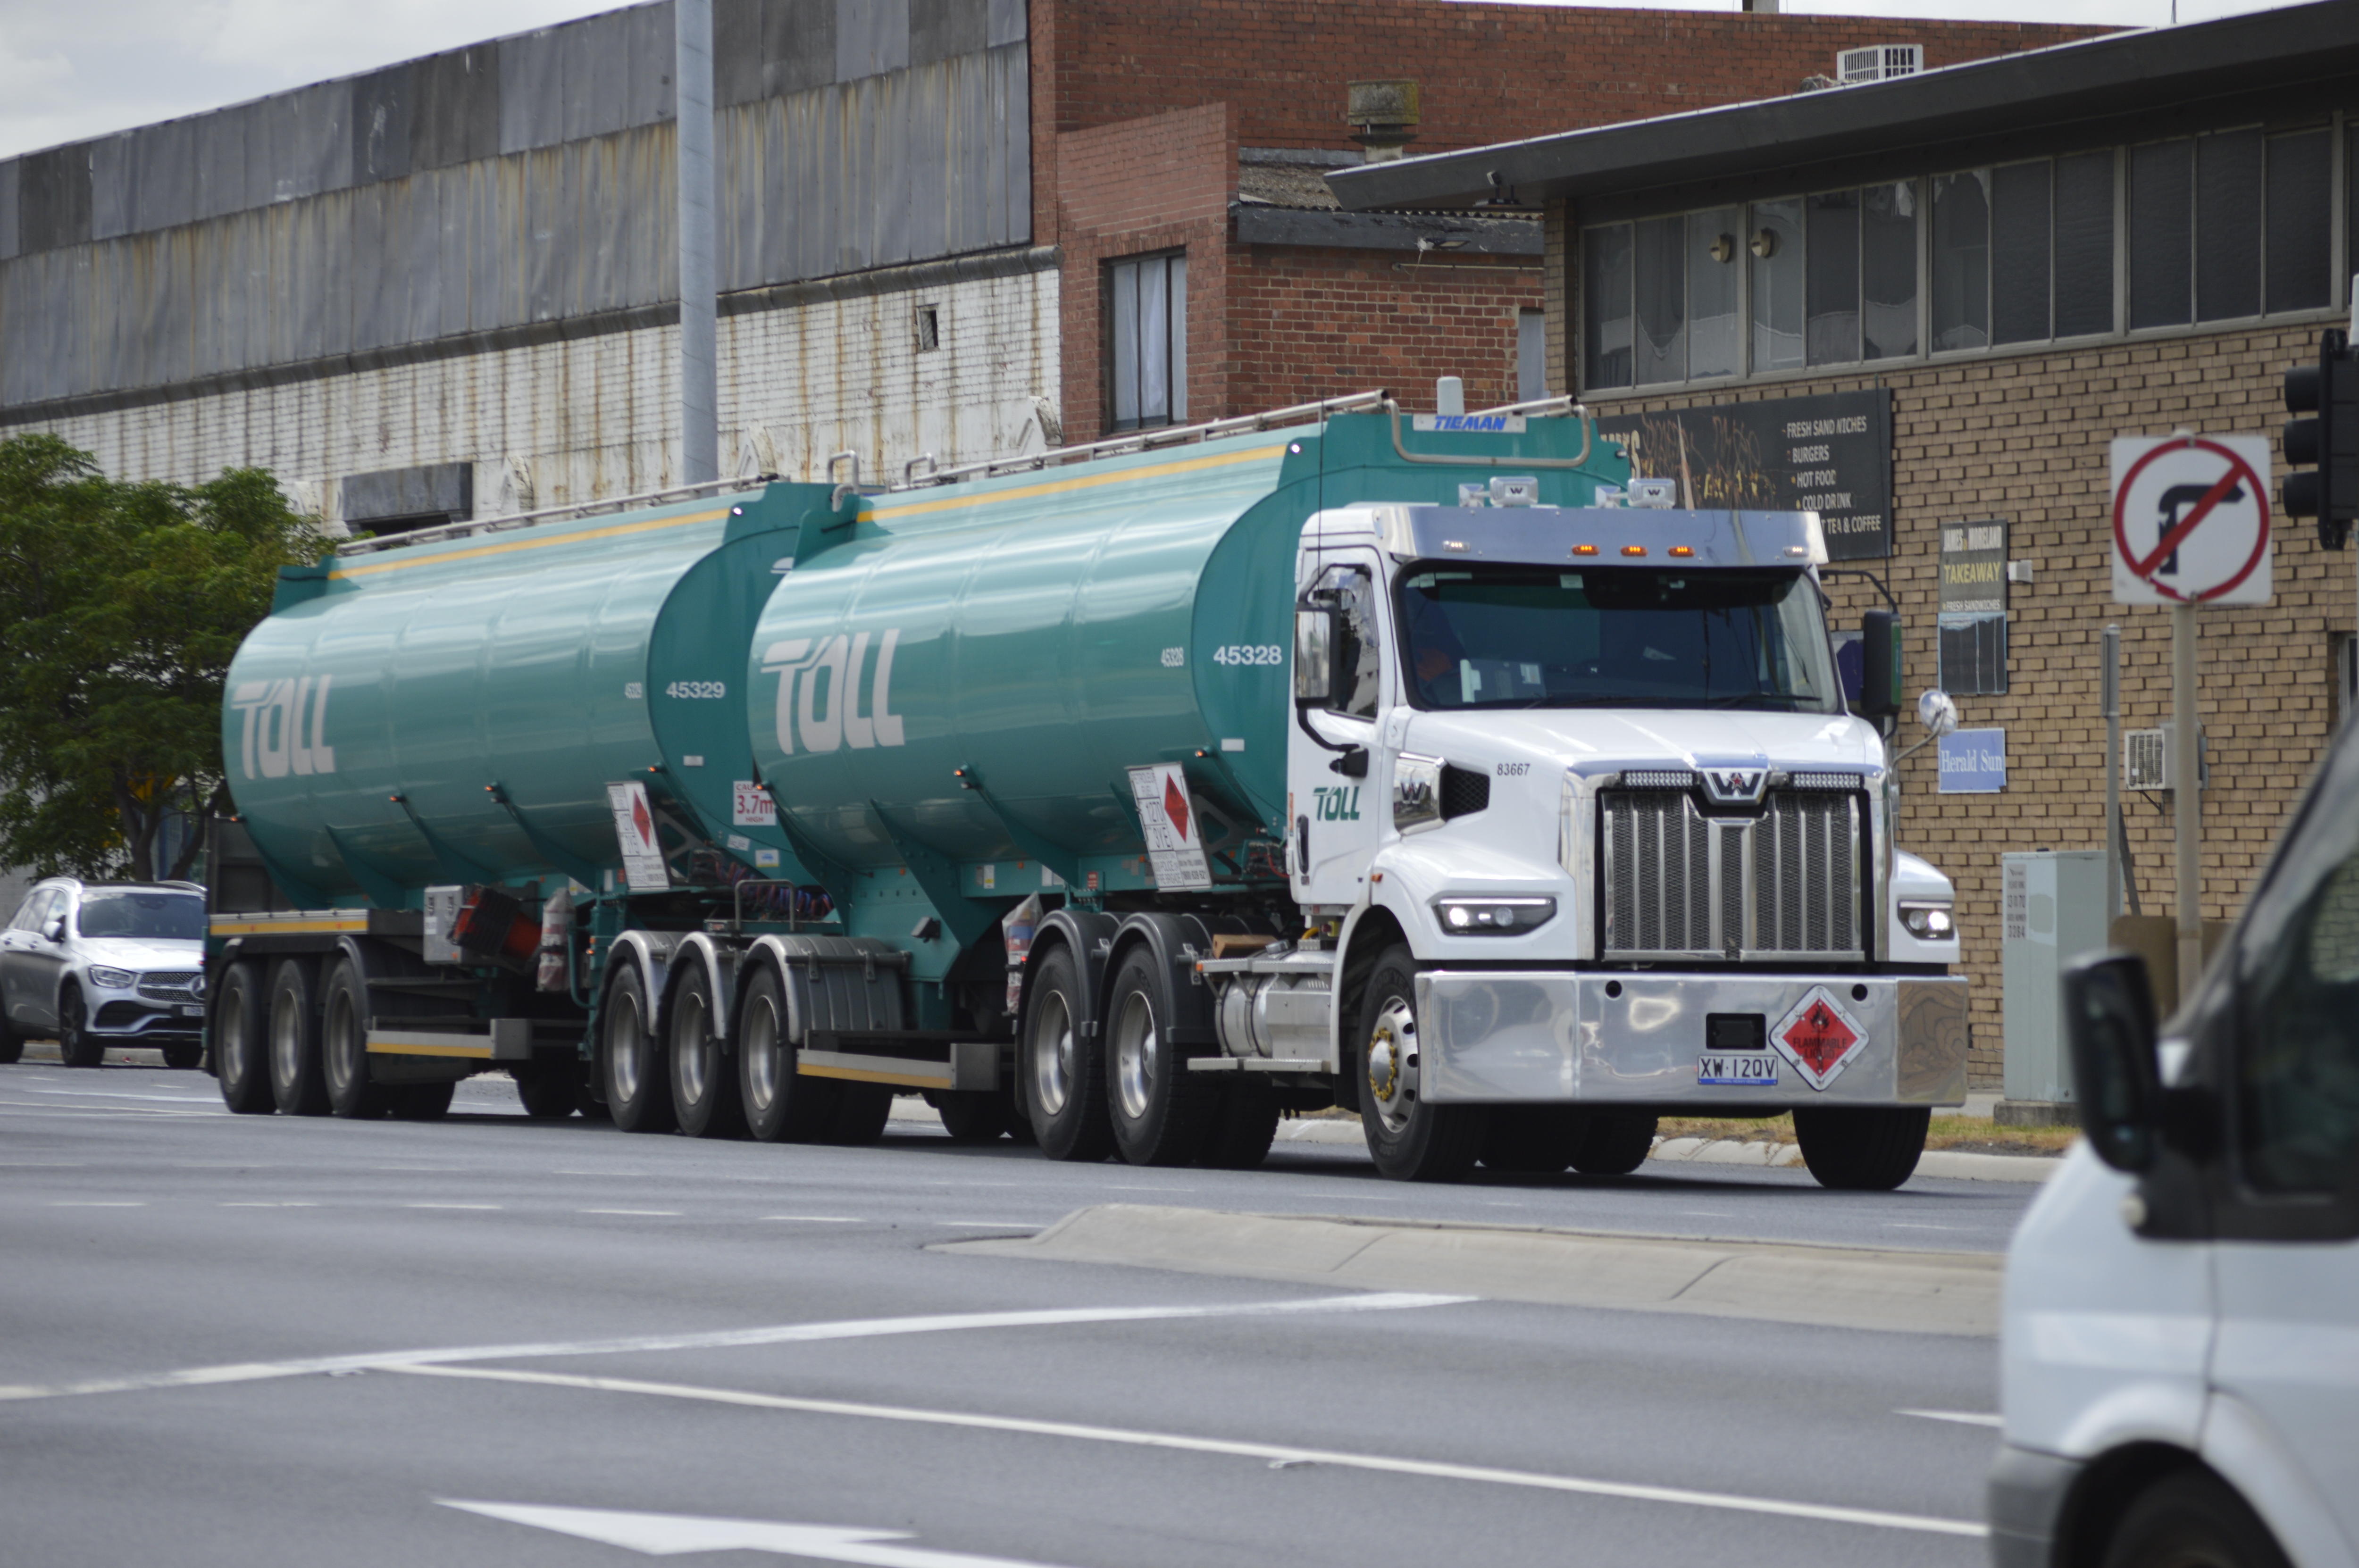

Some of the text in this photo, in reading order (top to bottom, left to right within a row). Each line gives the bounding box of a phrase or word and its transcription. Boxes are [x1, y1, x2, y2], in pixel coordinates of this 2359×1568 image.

[1434, 416, 1507, 430] TIEMAN
[1787, 421, 1812, 439] FRESH
[1792, 444, 1830, 464] BURGERS
[1797, 471, 1814, 488] HOT
[1802, 494, 1824, 511] COLD
[1827, 518, 1842, 534] TEA
[1843, 517, 1850, 533] &
[1851, 515, 1881, 533] COFFEE
[1944, 562, 2001, 584] TAKEAWAY
[1947, 599, 2001, 612] FRESH SANDWICHES
[1161, 645, 1282, 667] 45328 45328
[666, 681, 726, 699] 45329
[760, 628, 904, 755] TOLL
[230, 674, 335, 780] TOLL
[1497, 763, 1531, 776] 83667
[1941, 749, 2003, 772] Herald Sun
[737, 794, 773, 814] 3.7m
[1313, 786, 1360, 821] TOLL
[1793, 1037, 1847, 1050] FLAMMABLE
[1805, 1048, 1835, 1059] LIQUID
